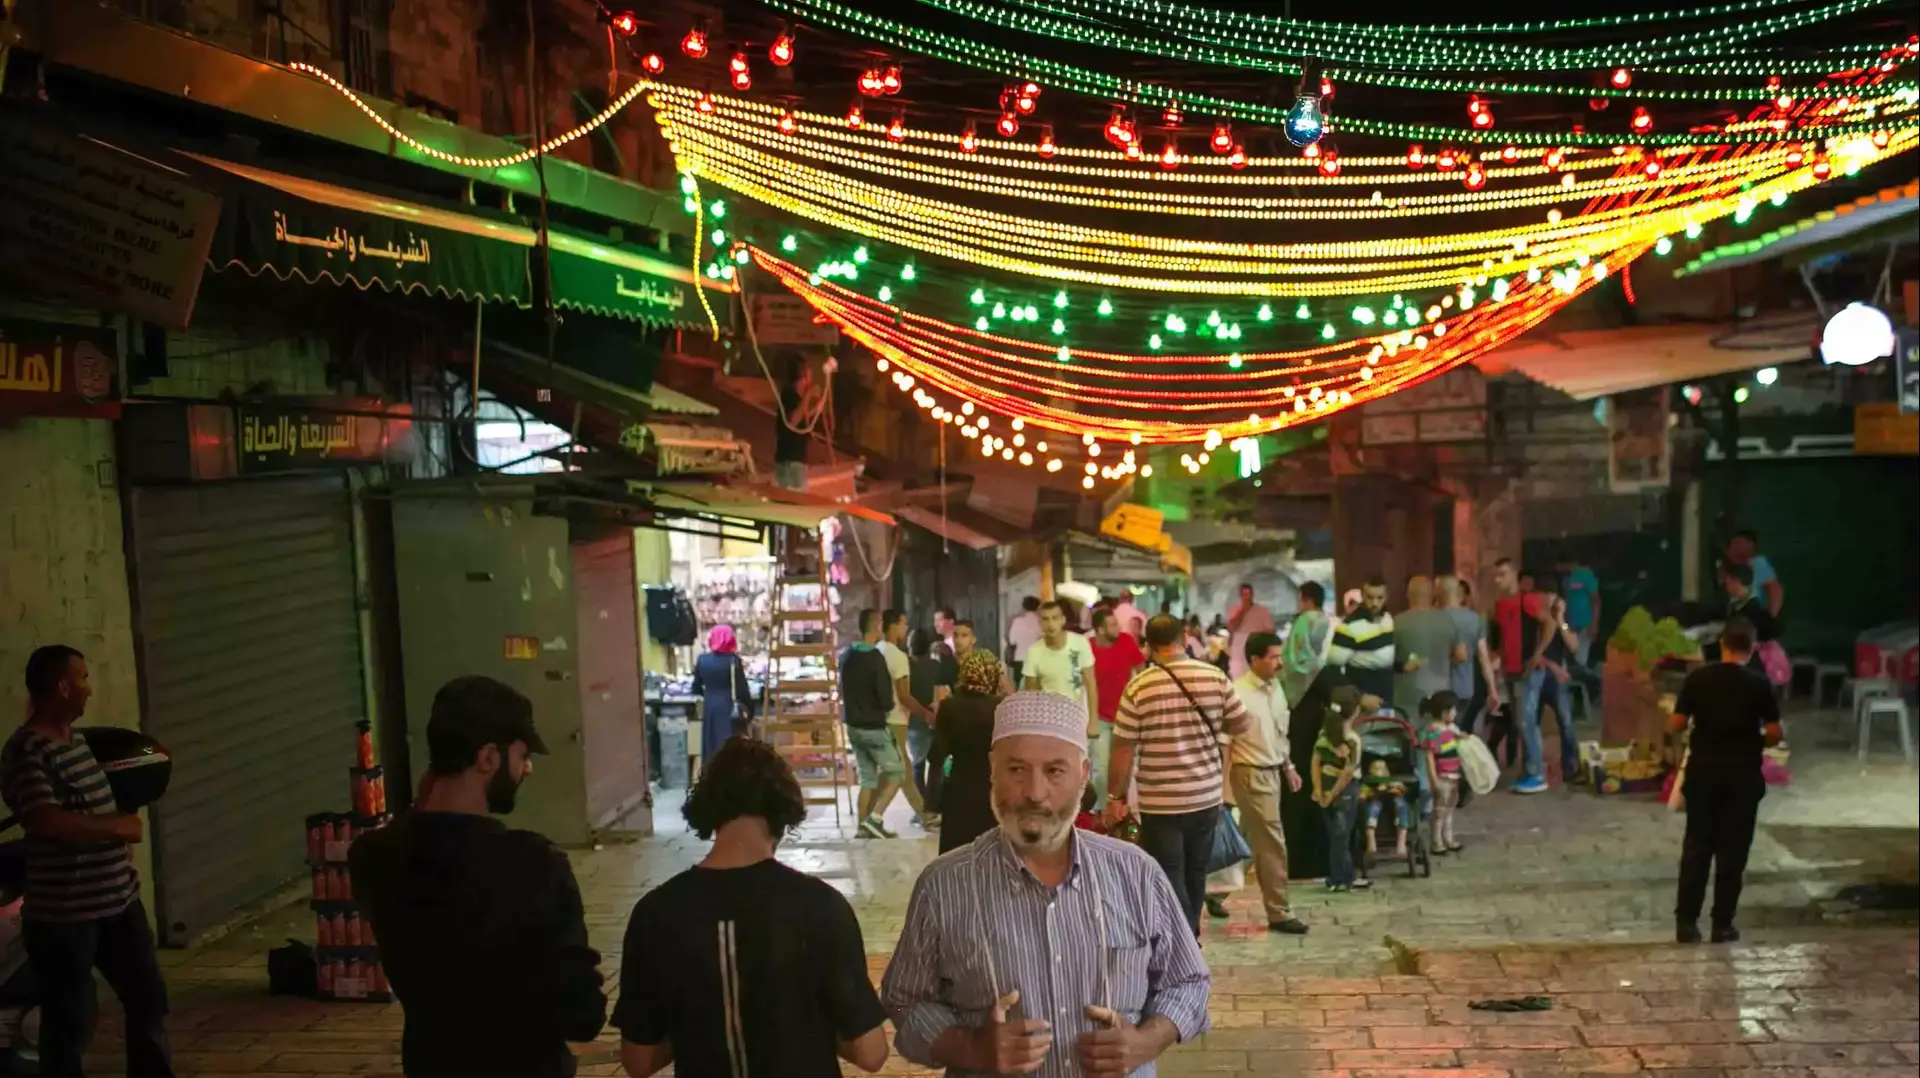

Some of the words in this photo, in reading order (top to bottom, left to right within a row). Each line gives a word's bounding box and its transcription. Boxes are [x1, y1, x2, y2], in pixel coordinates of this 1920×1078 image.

[274, 210, 356, 262] والحياة
[244, 415, 297, 462] والحياة
[301, 415, 355, 459] الشريعة
